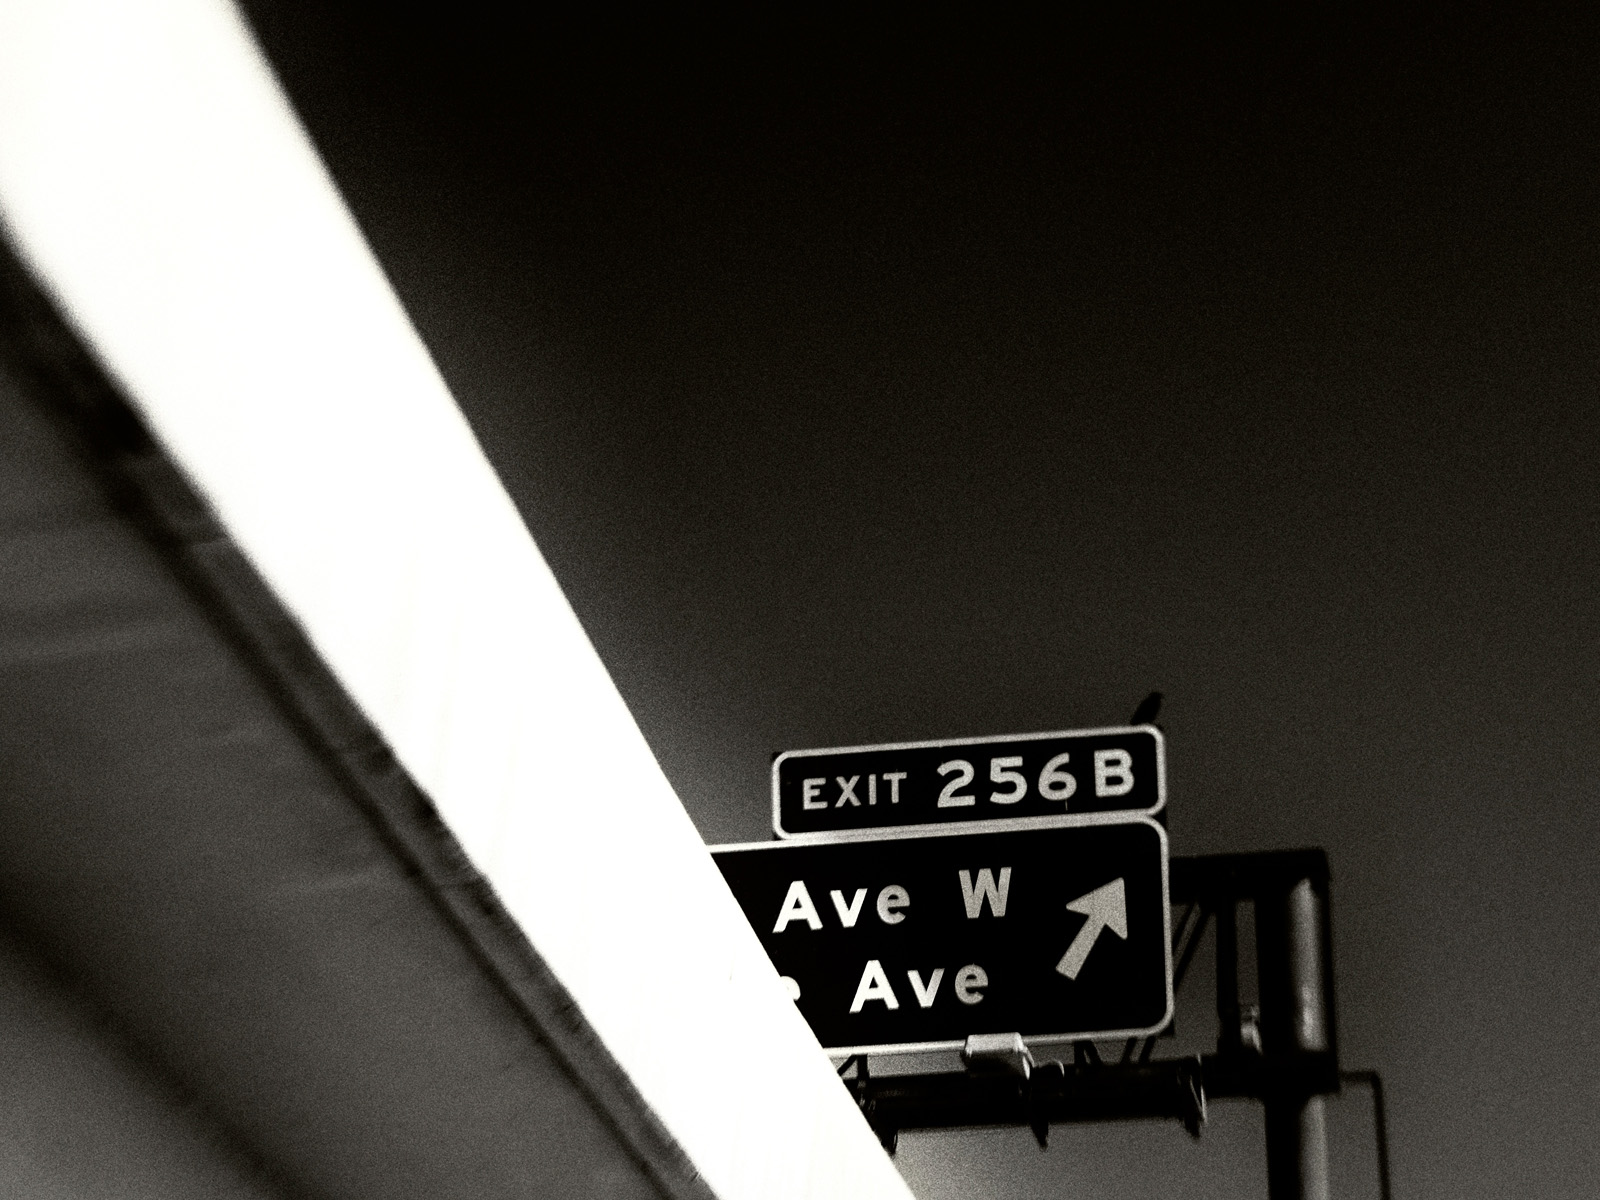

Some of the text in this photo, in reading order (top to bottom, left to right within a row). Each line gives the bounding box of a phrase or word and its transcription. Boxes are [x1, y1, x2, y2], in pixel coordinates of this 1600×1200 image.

[802, 748, 1135, 811] EXIT 256B
[772, 866, 1013, 934] Ave W
[849, 959, 989, 1014] Ave
